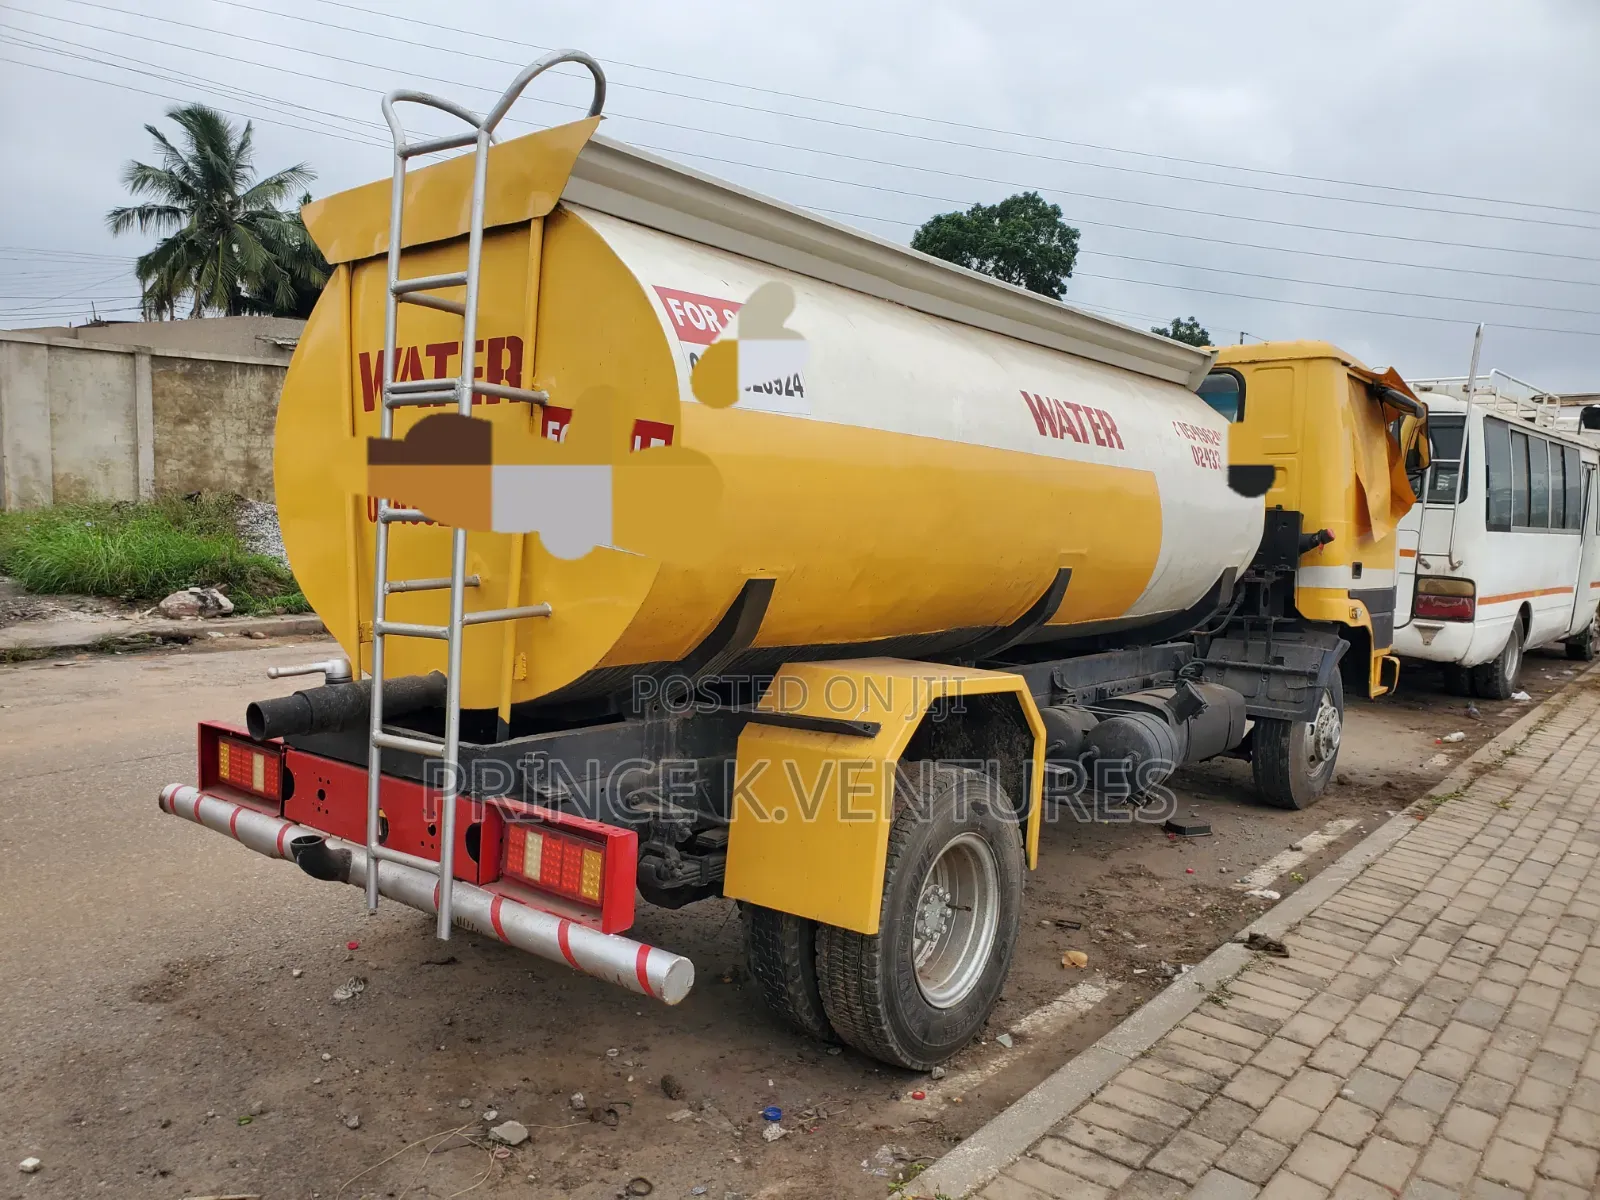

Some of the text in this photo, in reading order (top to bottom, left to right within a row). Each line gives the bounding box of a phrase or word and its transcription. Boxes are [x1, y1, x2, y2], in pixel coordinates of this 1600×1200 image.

[666, 297, 723, 333] FOR
[358, 335, 525, 413] WATER
[1019, 389, 1126, 451] WATER
